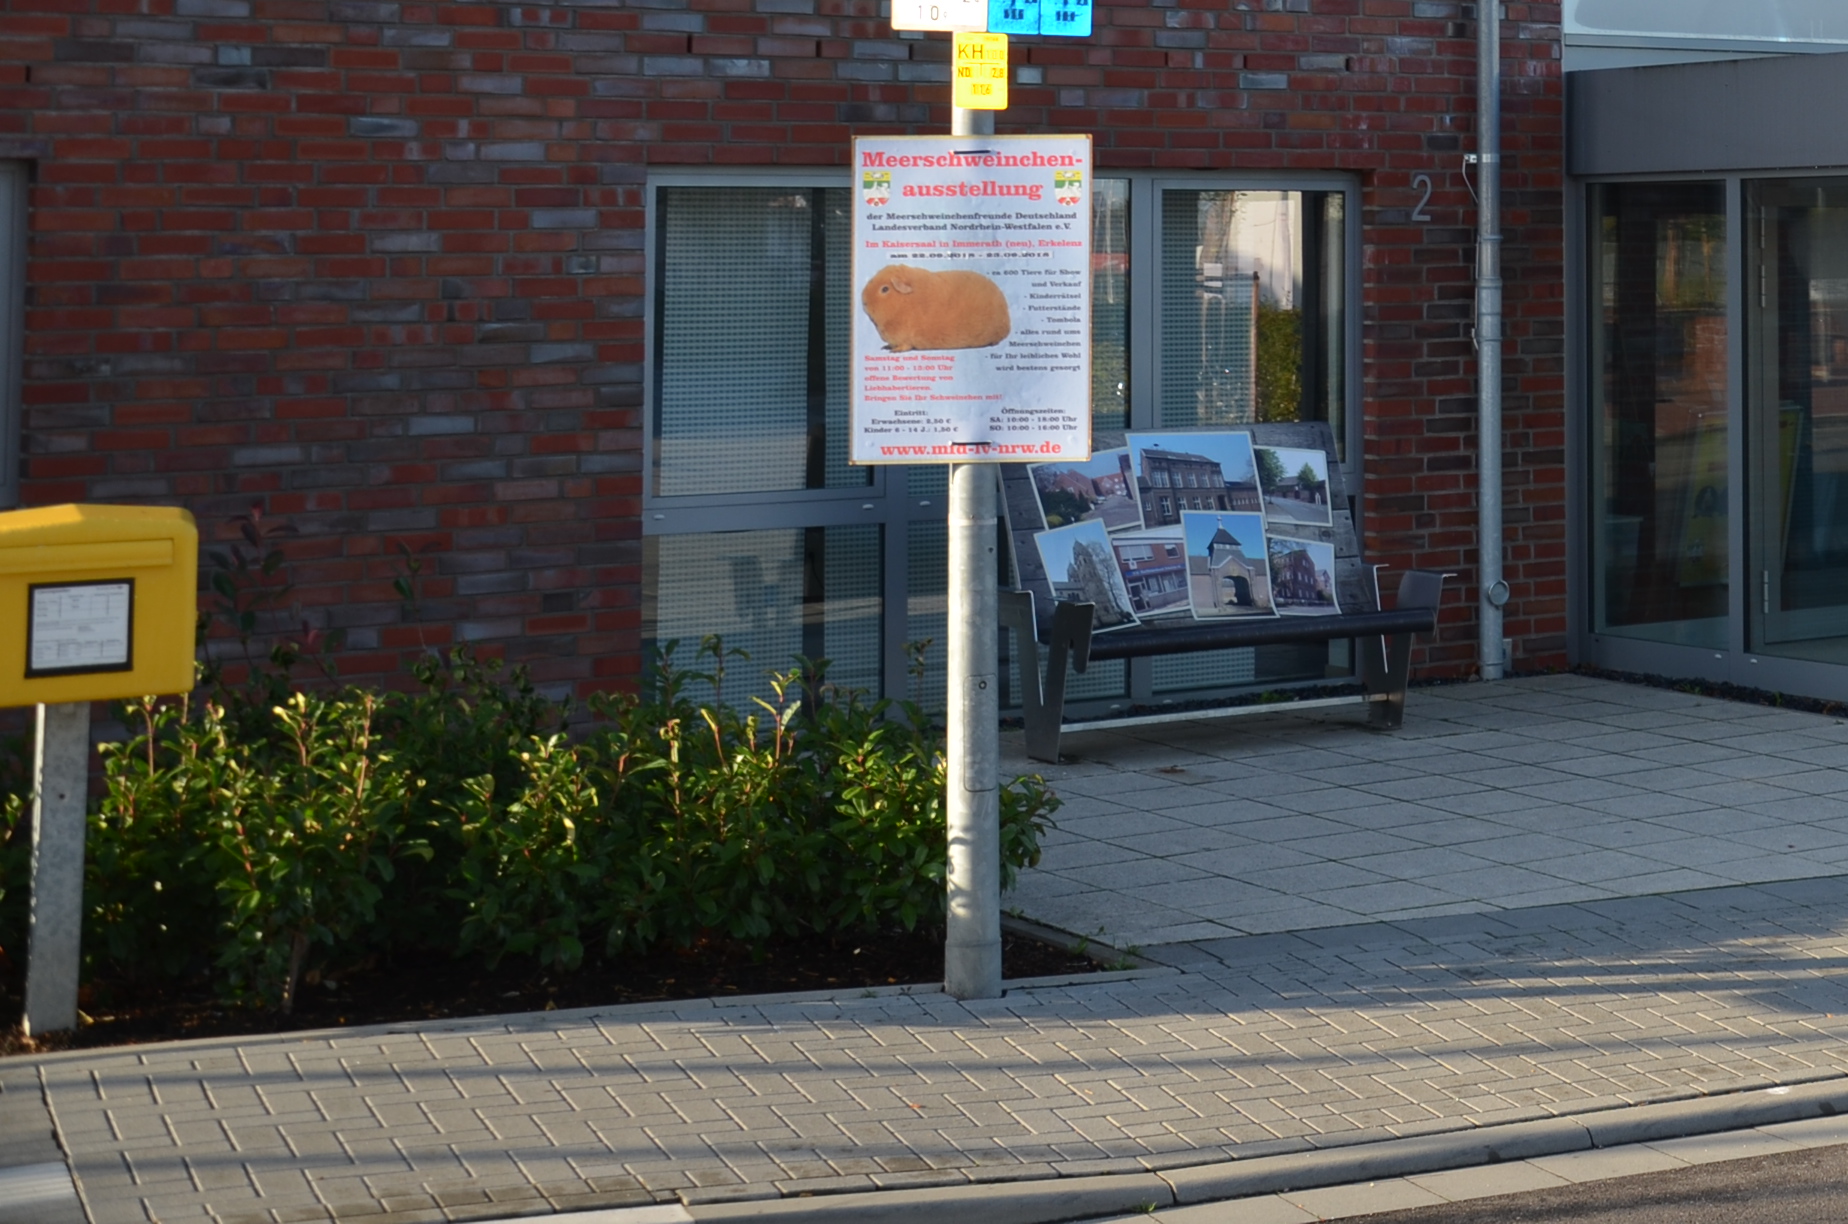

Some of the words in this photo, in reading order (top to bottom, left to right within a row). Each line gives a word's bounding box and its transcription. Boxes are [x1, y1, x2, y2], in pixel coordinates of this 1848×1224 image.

[862, 150, 1083, 167] Meerschweinchen-
[902, 180, 1043, 201] ausstellung
[1411, 174, 1432, 222] 2
[866, 212, 883, 220] der
[886, 212, 1013, 220] Meerschweinchenfreunde
[1015, 212, 1077, 220] Deutschland
[872, 223, 948, 231] Landesverband
[950, 222, 1053, 230] Nordrhein-Westfalen
[865, 240, 879, 248] Im
[882, 240, 937, 248] Kaisersaal
[939, 240, 949, 248] in
[952, 239, 1002, 247] Immerath
[1038, 239, 1083, 247] Erkelenz
